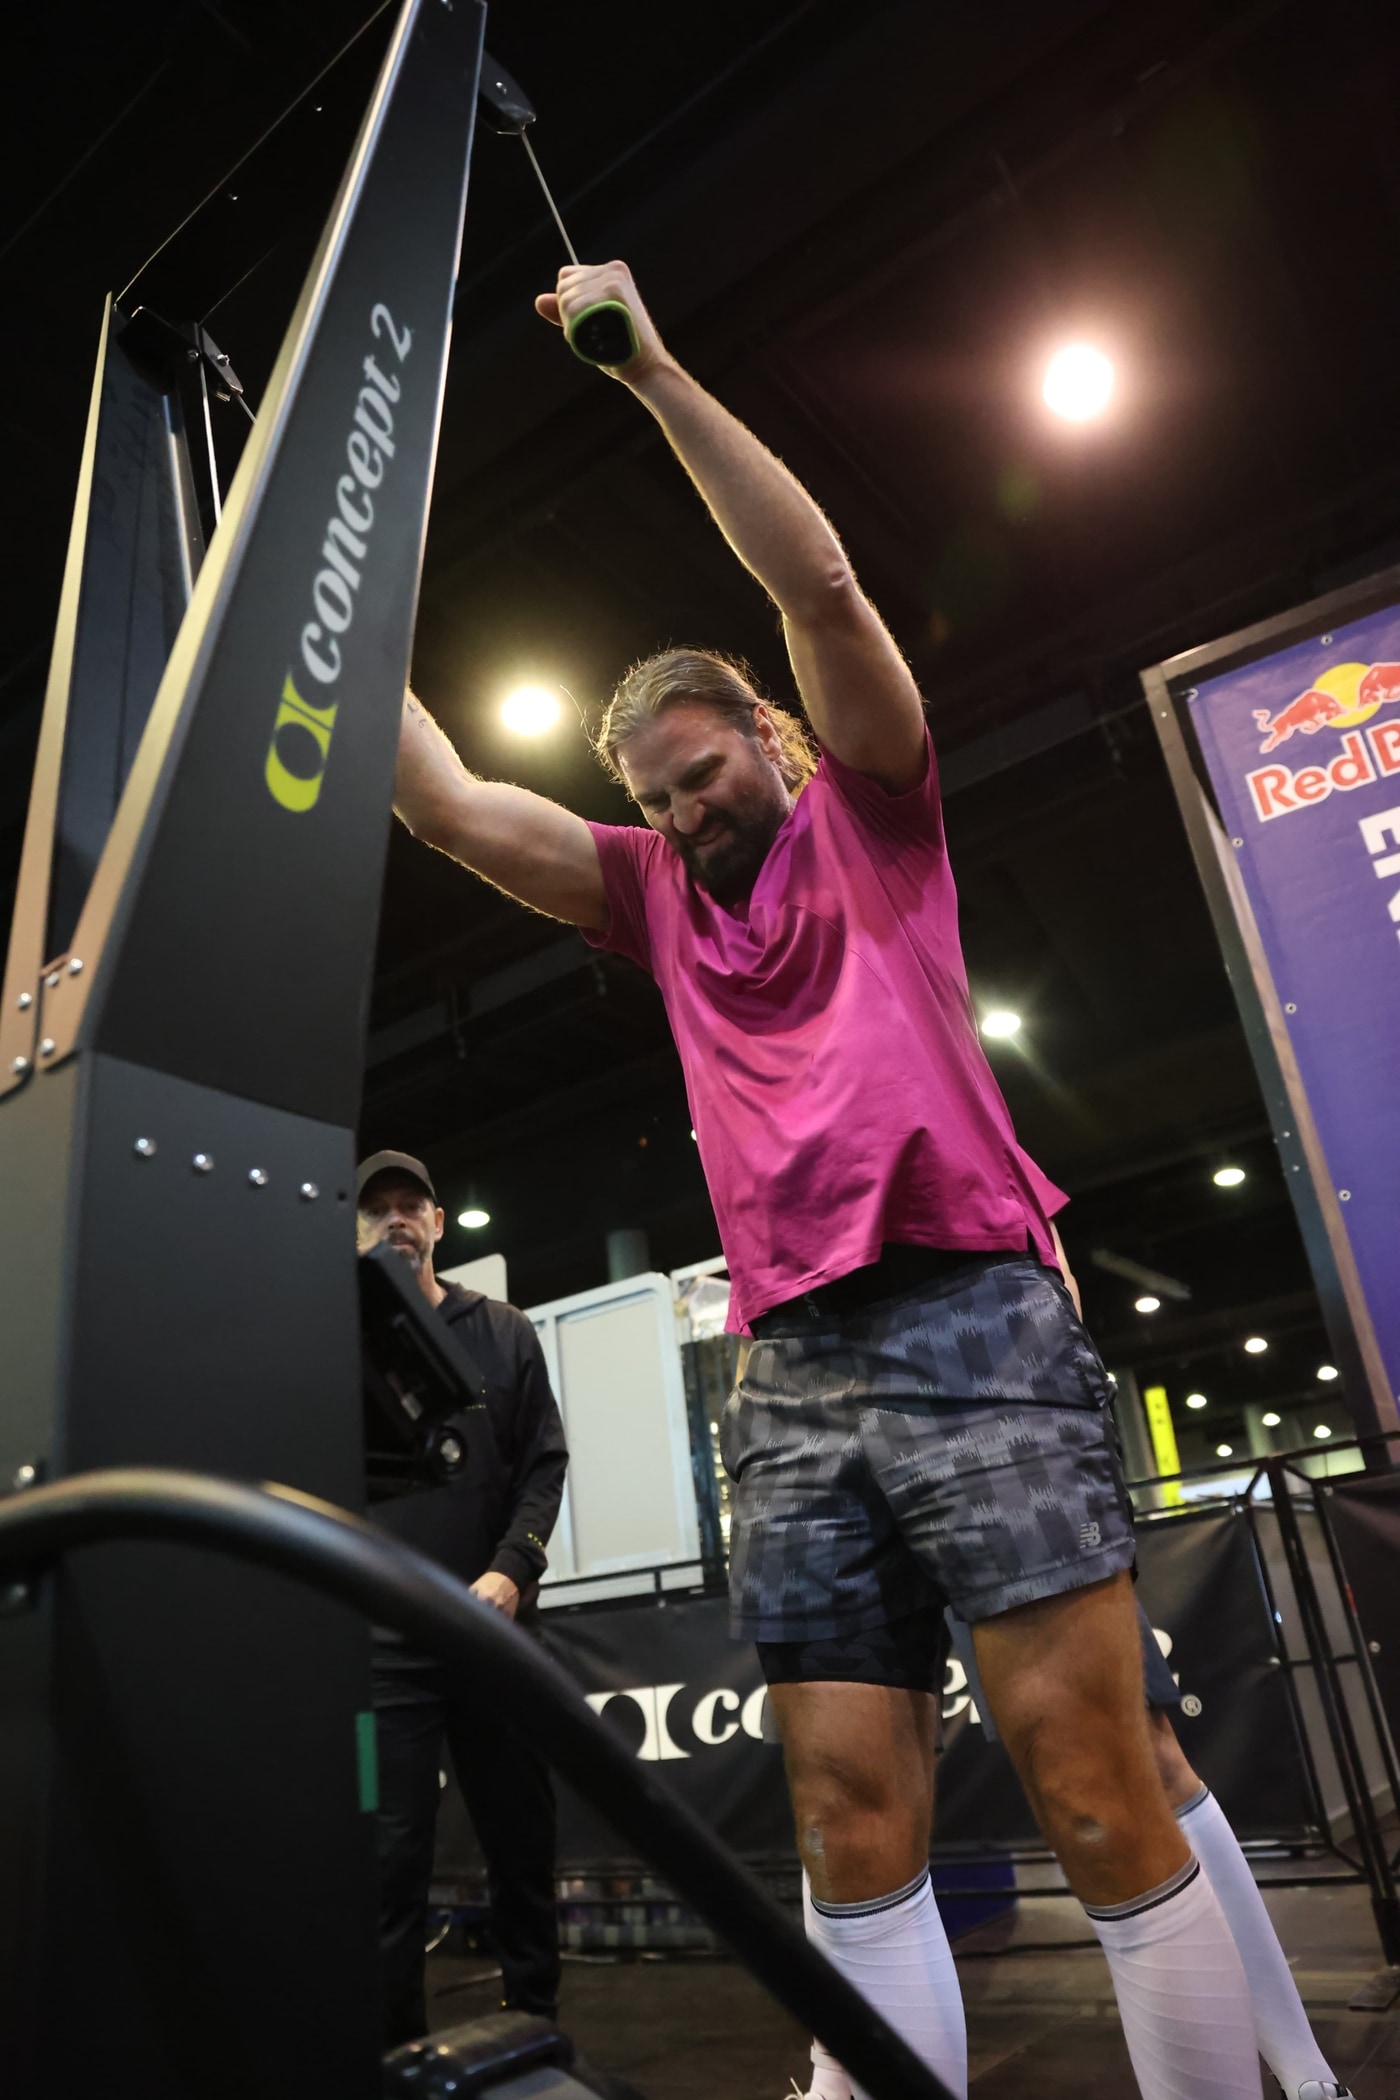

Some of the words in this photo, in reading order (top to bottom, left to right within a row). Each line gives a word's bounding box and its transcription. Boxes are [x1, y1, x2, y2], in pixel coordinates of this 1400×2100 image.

[301, 354, 401, 684] concept
[370, 303, 412, 362] 2
[1245, 729, 1377, 823] Red
